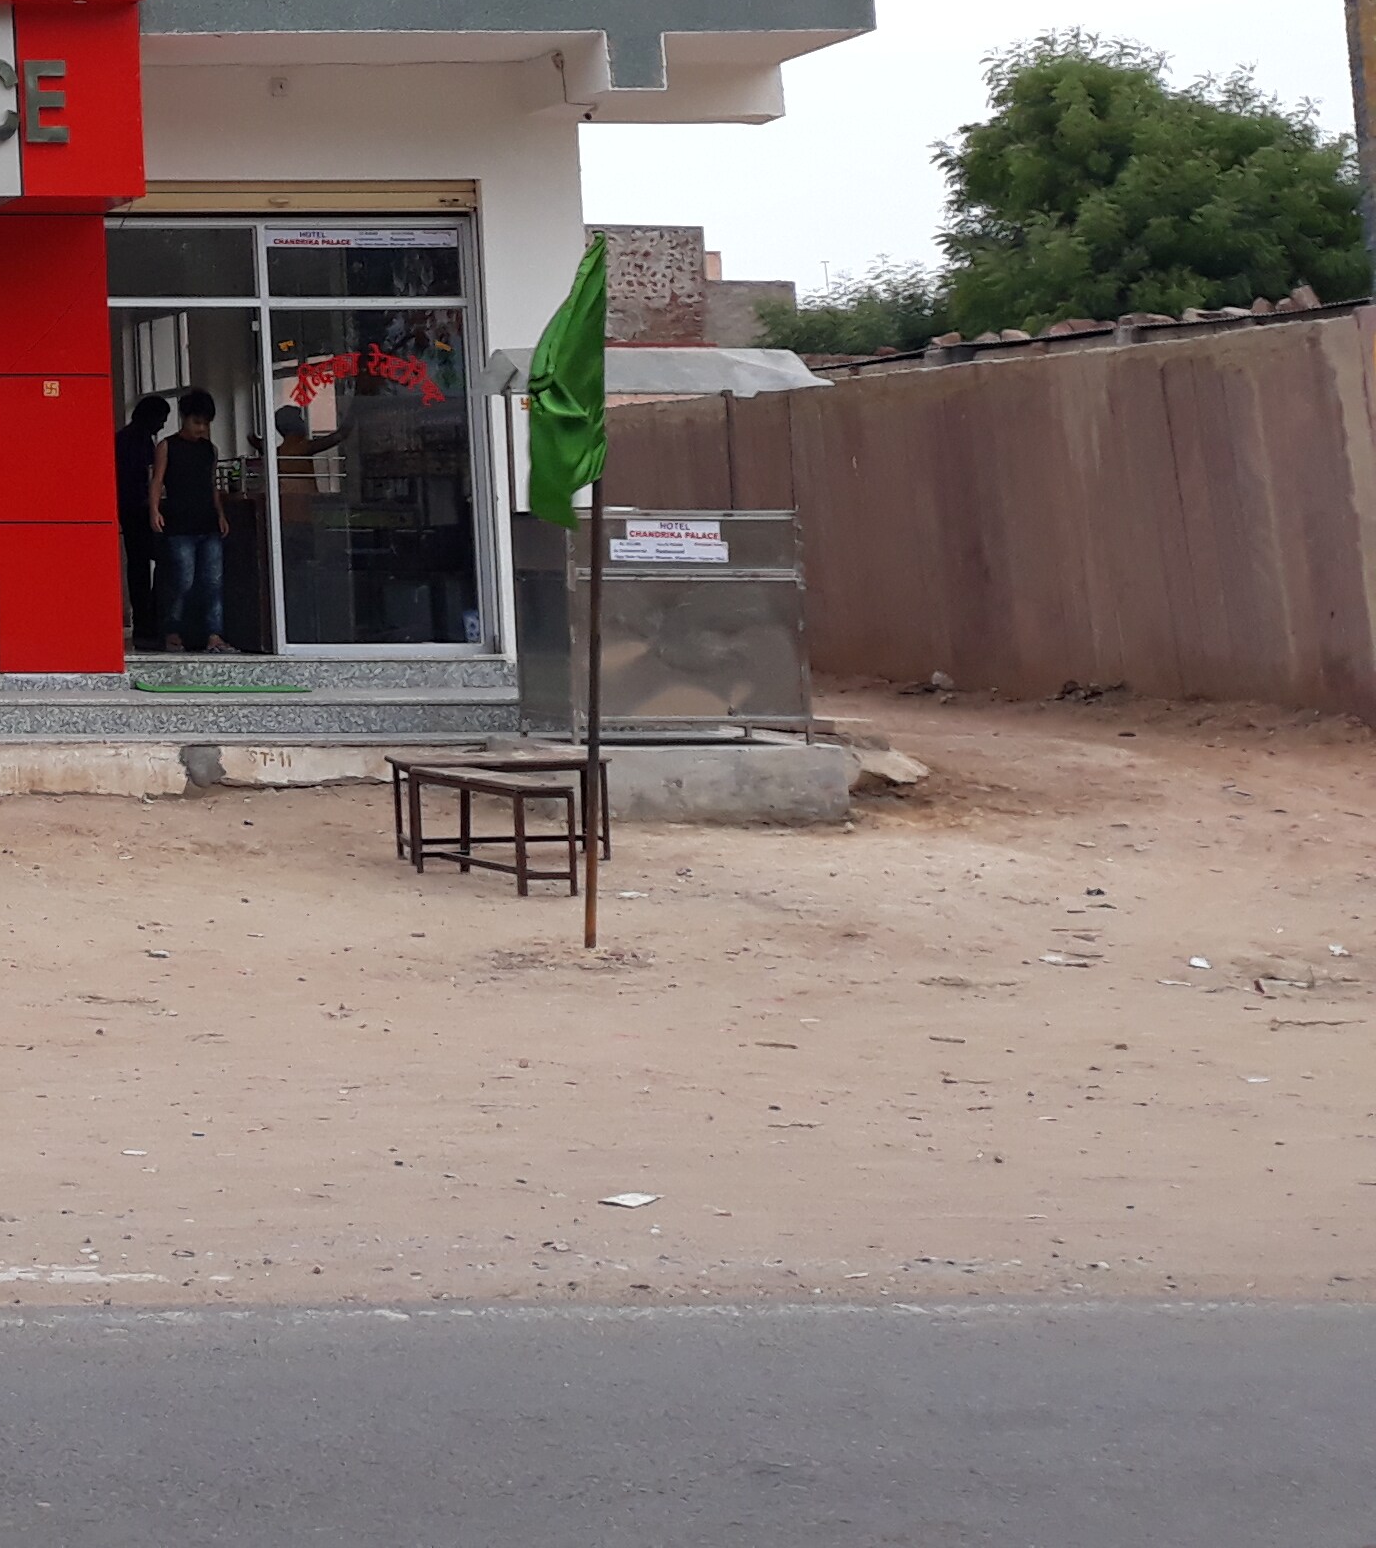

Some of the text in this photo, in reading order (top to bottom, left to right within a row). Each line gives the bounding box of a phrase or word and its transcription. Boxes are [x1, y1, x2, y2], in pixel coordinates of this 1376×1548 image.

[660, 522, 690, 530] HOTEL
[629, 530, 719, 540] CHANDRIKA PALACE
